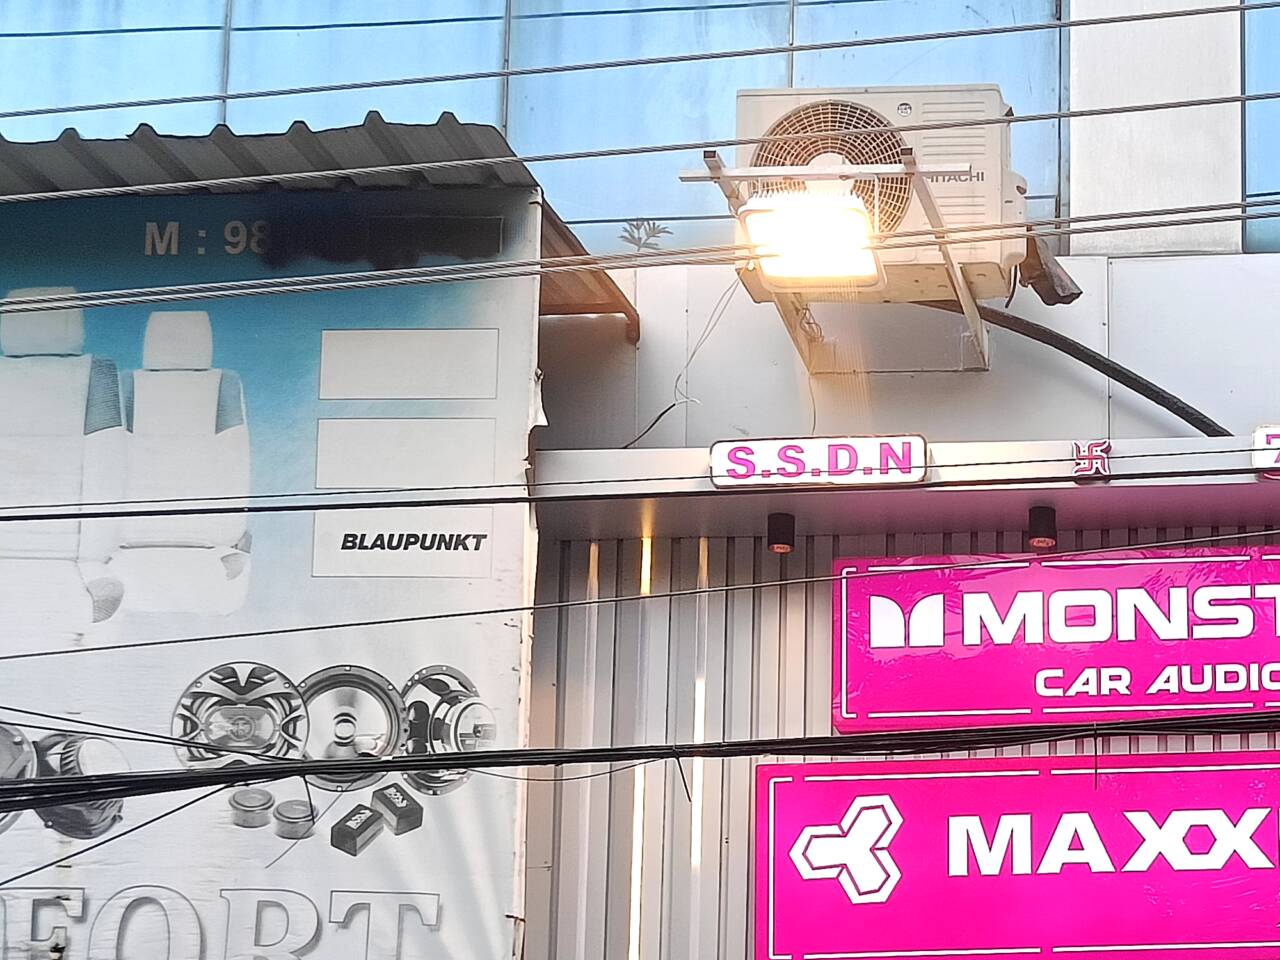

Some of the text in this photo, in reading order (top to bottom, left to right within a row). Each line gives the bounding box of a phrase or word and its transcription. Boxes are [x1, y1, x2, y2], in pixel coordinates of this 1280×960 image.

[144, 221, 180, 256] M
[726, 442, 913, 479] S.S.D.N
[340, 531, 488, 553] BLAUPUNKT
[1035, 667, 1131, 698] CAR
